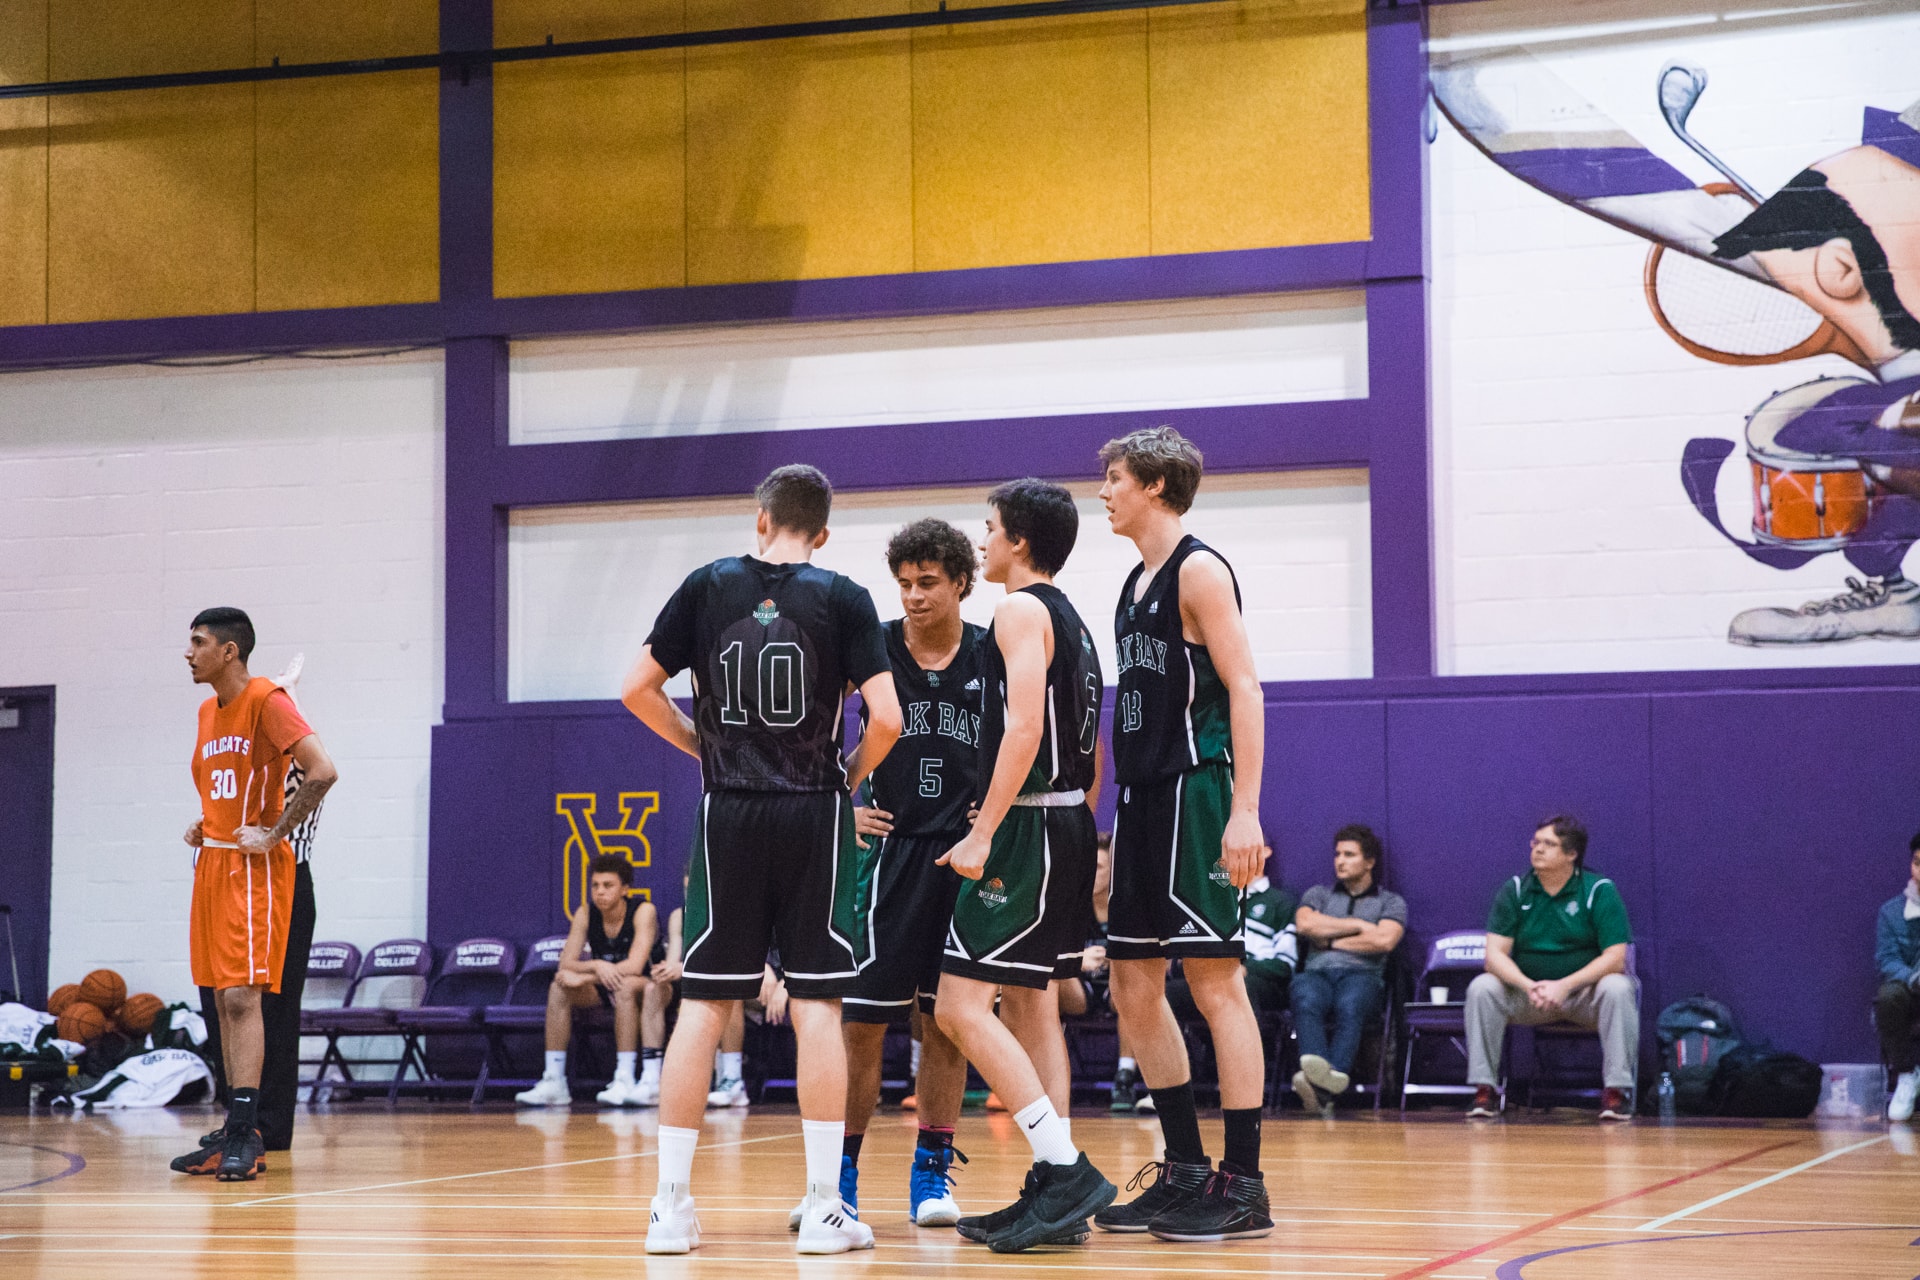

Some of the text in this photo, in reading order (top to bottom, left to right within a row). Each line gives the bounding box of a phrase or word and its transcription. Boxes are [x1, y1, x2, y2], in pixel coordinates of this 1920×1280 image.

[720, 641, 805, 726] 10
[1122, 690, 1142, 733] 13
[210, 768, 238, 800] 30
[918, 758, 943, 798] 5
[309, 946, 349, 960] ANCOUVER
[374, 944, 421, 958] VANCOUVER
[456, 943, 505, 957] VANCOUVER
[373, 956, 418, 967] COLLEGE
[456, 955, 501, 967] COLLEGE
